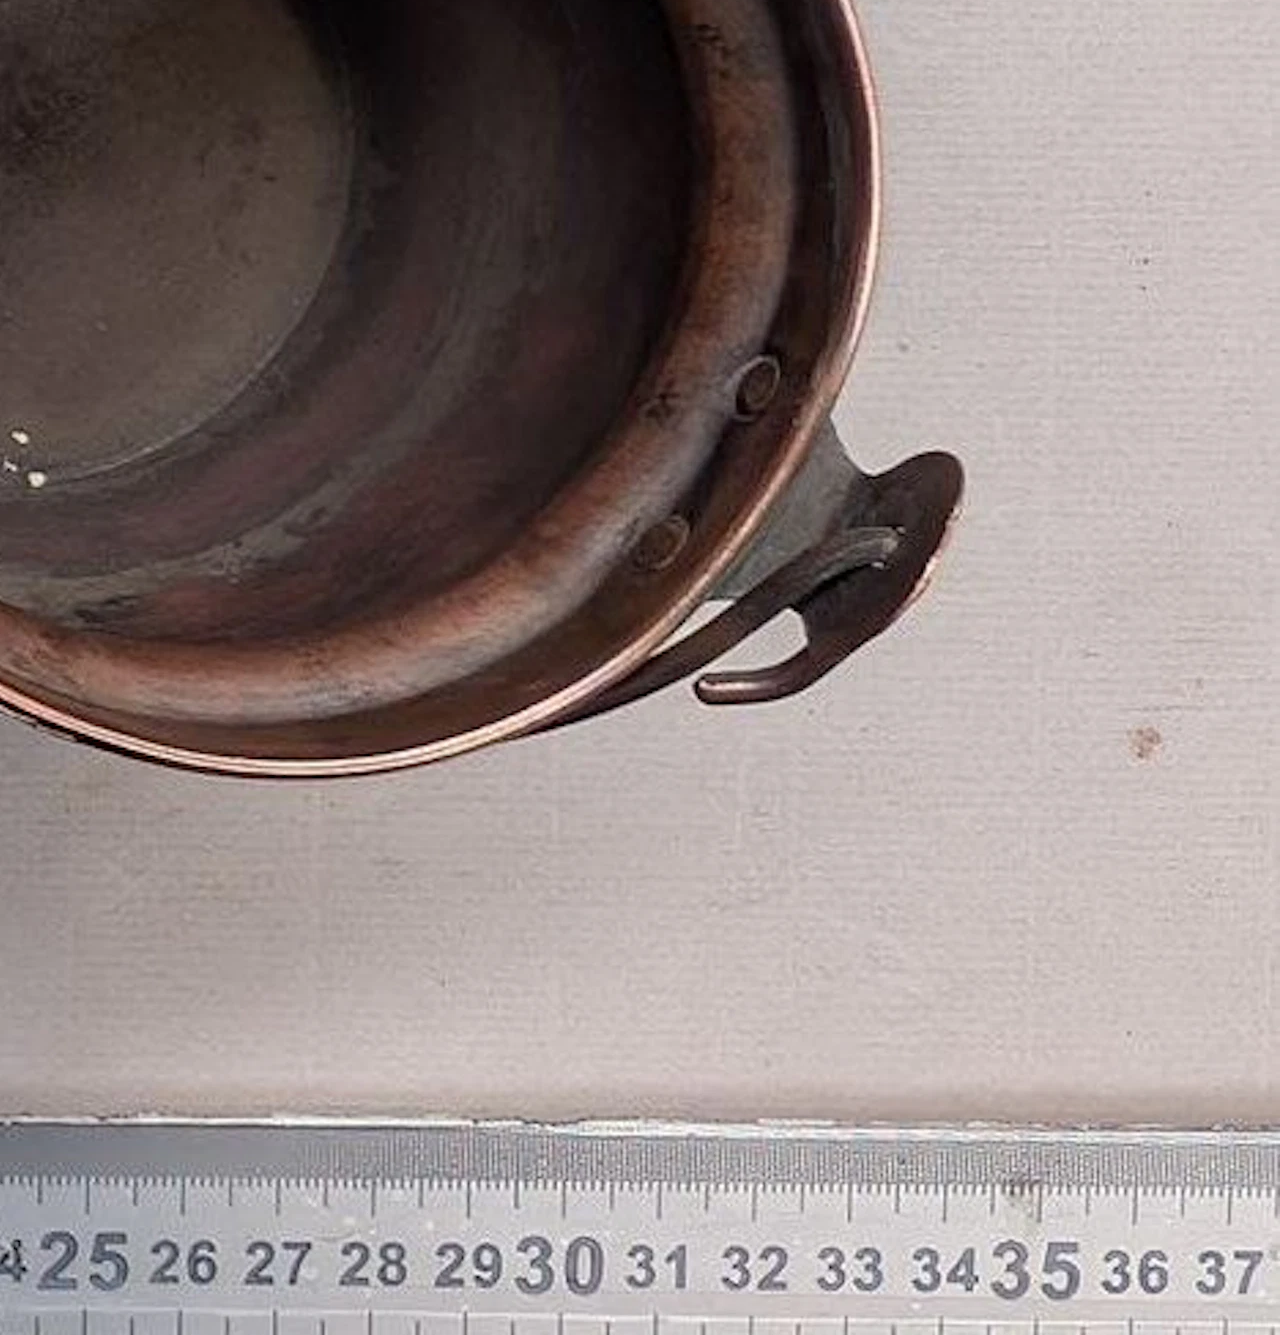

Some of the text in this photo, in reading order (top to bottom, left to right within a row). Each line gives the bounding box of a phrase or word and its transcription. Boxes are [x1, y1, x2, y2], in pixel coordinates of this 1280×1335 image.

[37, 1231, 129, 1291] 25
[149, 1240, 217, 1284] 26
[244, 1241, 312, 1286] 27
[339, 1242, 407, 1286] 28
[435, 1243, 502, 1288] 29
[514, 1236, 604, 1296] 30
[626, 1245, 686, 1289] 31
[721, 1246, 788, 1291] 32
[817, 1247, 883, 1291] 33
[911, 1248, 979, 1292] 34
[990, 1239, 1080, 1301] 35
[1101, 1250, 1168, 1294] 36
[1196, 1250, 1263, 1294] 37
